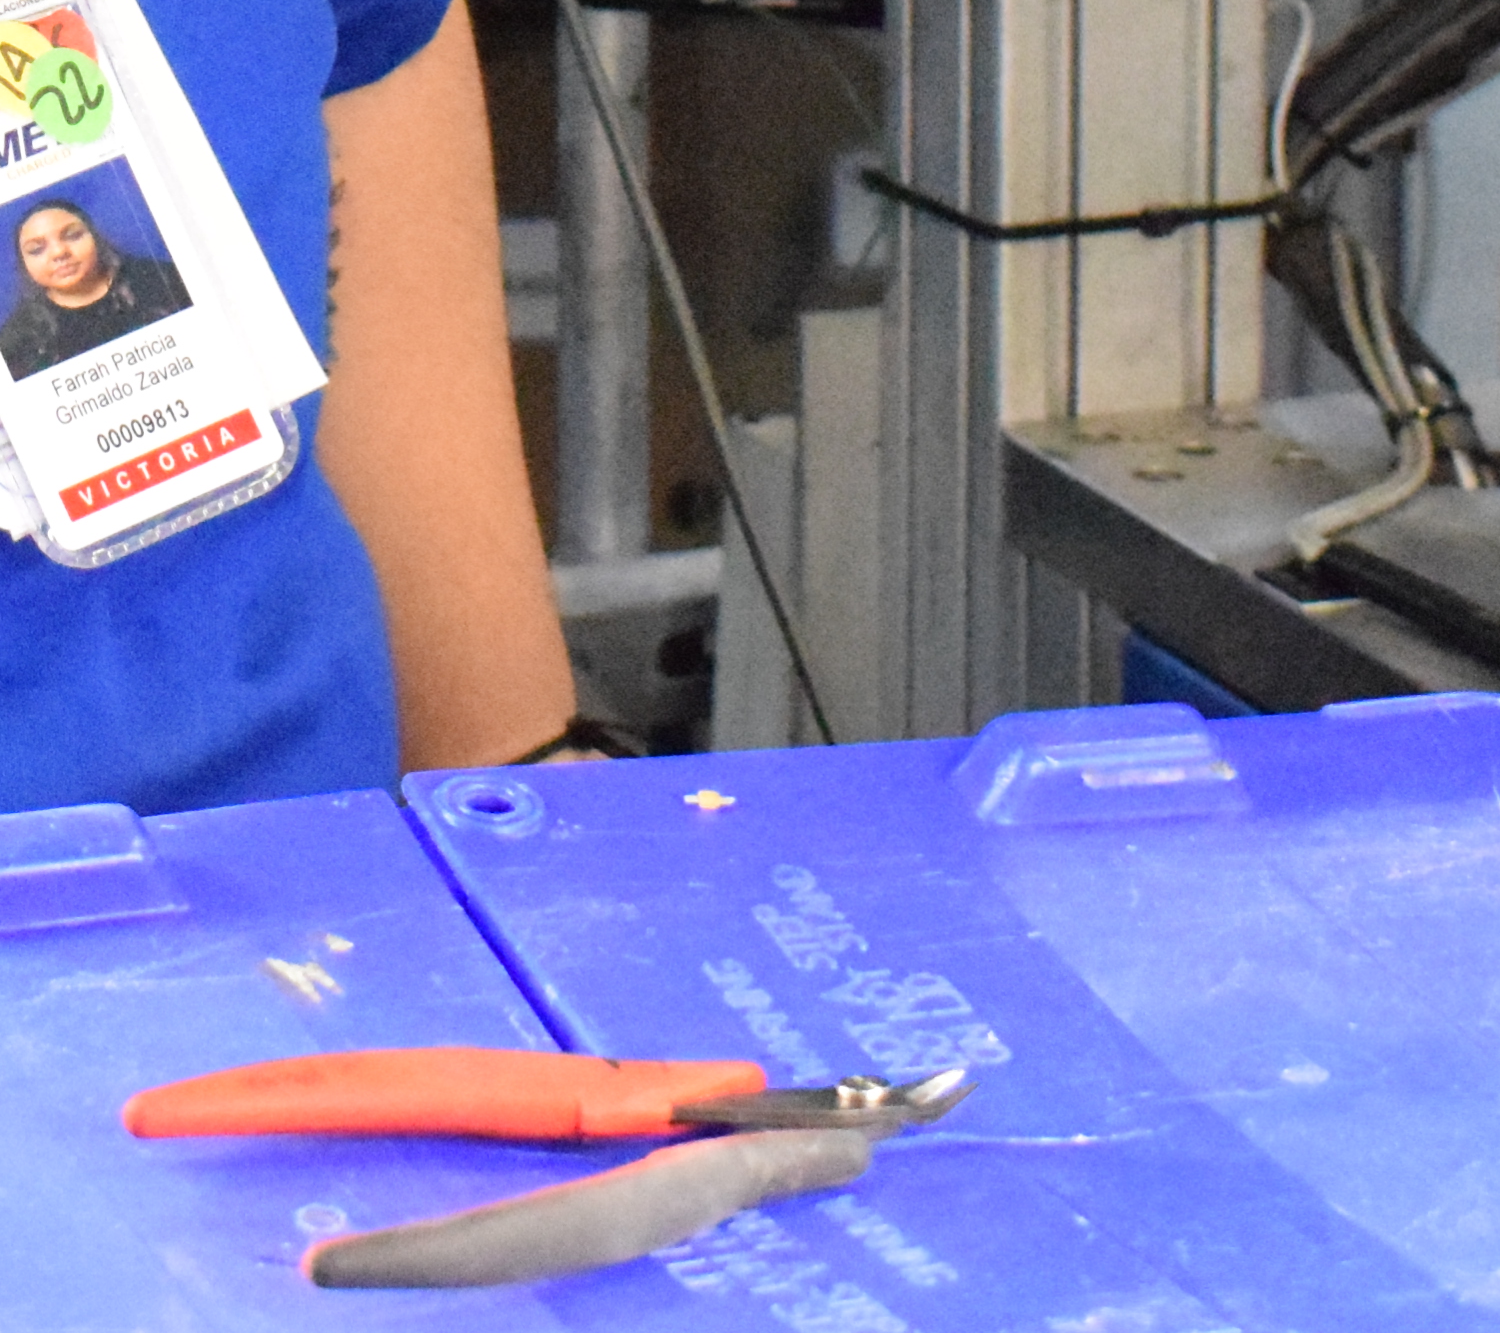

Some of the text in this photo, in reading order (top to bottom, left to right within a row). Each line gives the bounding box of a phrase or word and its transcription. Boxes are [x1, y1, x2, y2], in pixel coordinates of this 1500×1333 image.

[29, 61, 104, 125] 22
[52, 332, 177, 397] Farrah Patricia
[56, 354, 194, 424] Grimaldo Zavala
[97, 399, 189, 453] 00009813
[78, 426, 235, 506] VICTORIA
